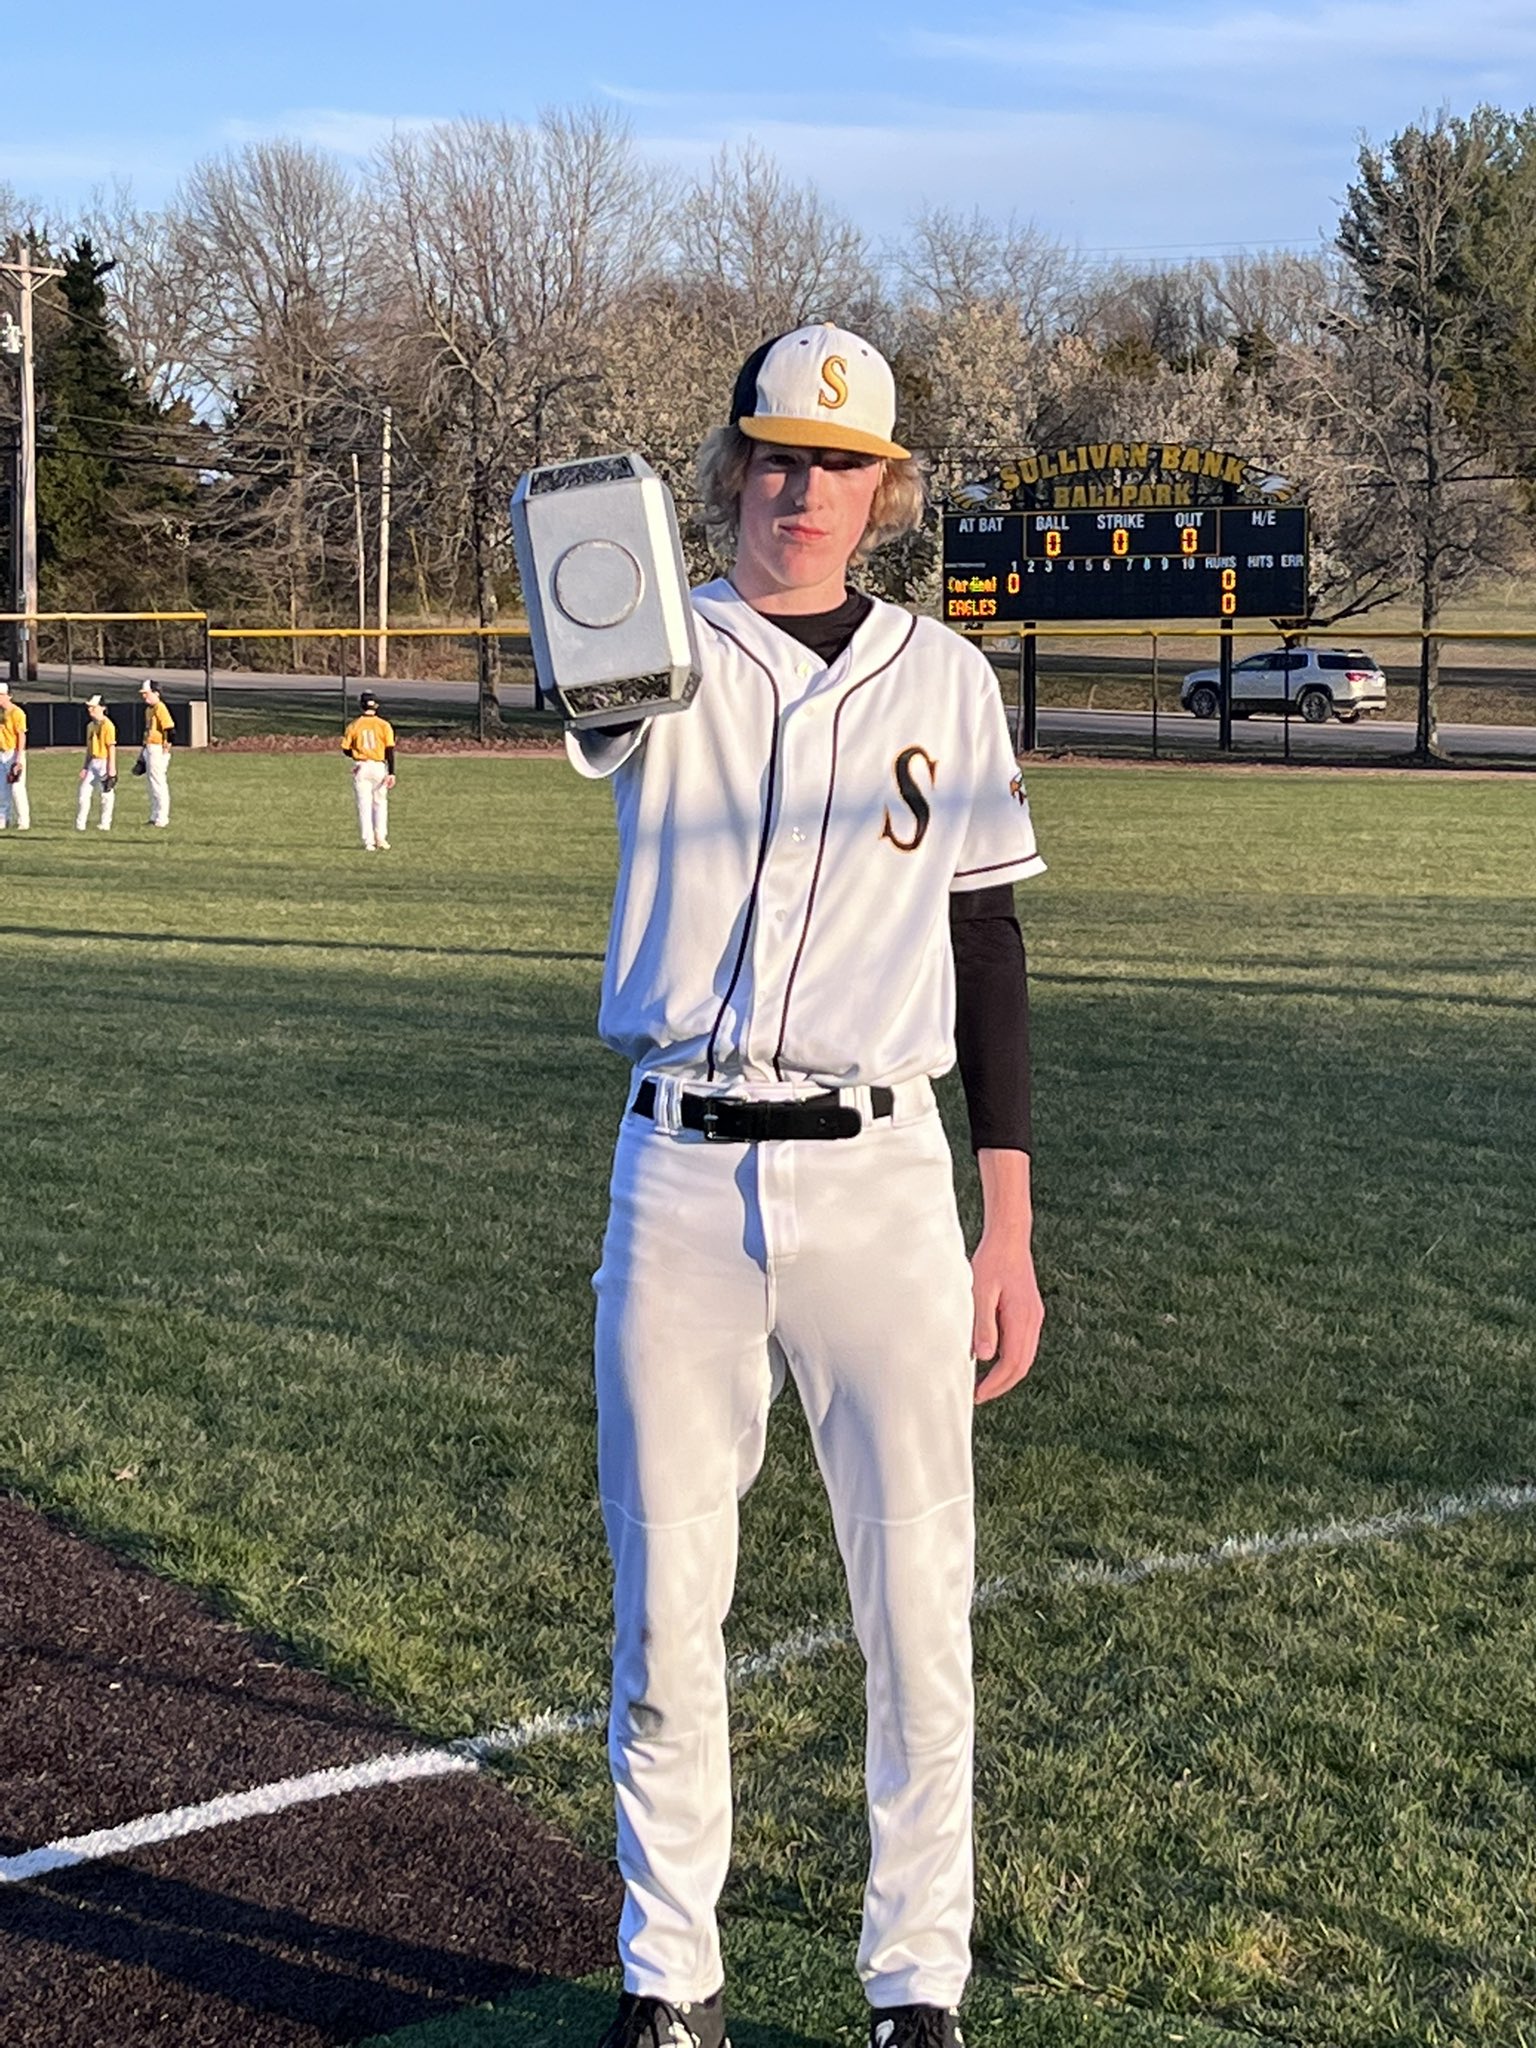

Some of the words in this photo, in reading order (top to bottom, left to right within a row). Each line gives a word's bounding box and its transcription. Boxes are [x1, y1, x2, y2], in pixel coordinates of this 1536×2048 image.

[818, 355, 848, 409] S
[1000, 441, 1150, 491] SULLIVAN
[1160, 444, 1247, 485] BANK
[1053, 483, 1192, 508] BALLPARK
[959, 518, 975, 533] AT
[979, 516, 1004, 532] BAT
[1035, 515, 1070, 531] BALL
[1096, 513, 1145, 530] STRIKE
[1174, 512, 1204, 528] OUT
[1251, 509, 1277, 527] H/E
[1046, 531, 1061, 556] 0
[1113, 528, 1129, 555] 0
[1182, 527, 1198, 553] 0
[1011, 560, 1018, 572] 1
[1027, 560, 1035, 573] 2
[1044, 560, 1053, 573] 3
[1067, 559, 1075, 572] 4
[1085, 558, 1093, 572] 5
[1103, 558, 1111, 572] 6
[1126, 557, 1133, 572] 7
[1143, 556, 1151, 571] 8
[1161, 556, 1169, 571] 9
[1182, 557, 1195, 570] 10
[1205, 555, 1237, 569] RUNS
[1247, 555, 1274, 568] HITS
[1281, 554, 1304, 567] ERR
[1007, 572, 1020, 594] 0
[1221, 568, 1236, 590] 0
[1221, 592, 1236, 614] 0
[881, 744, 936, 852] S
